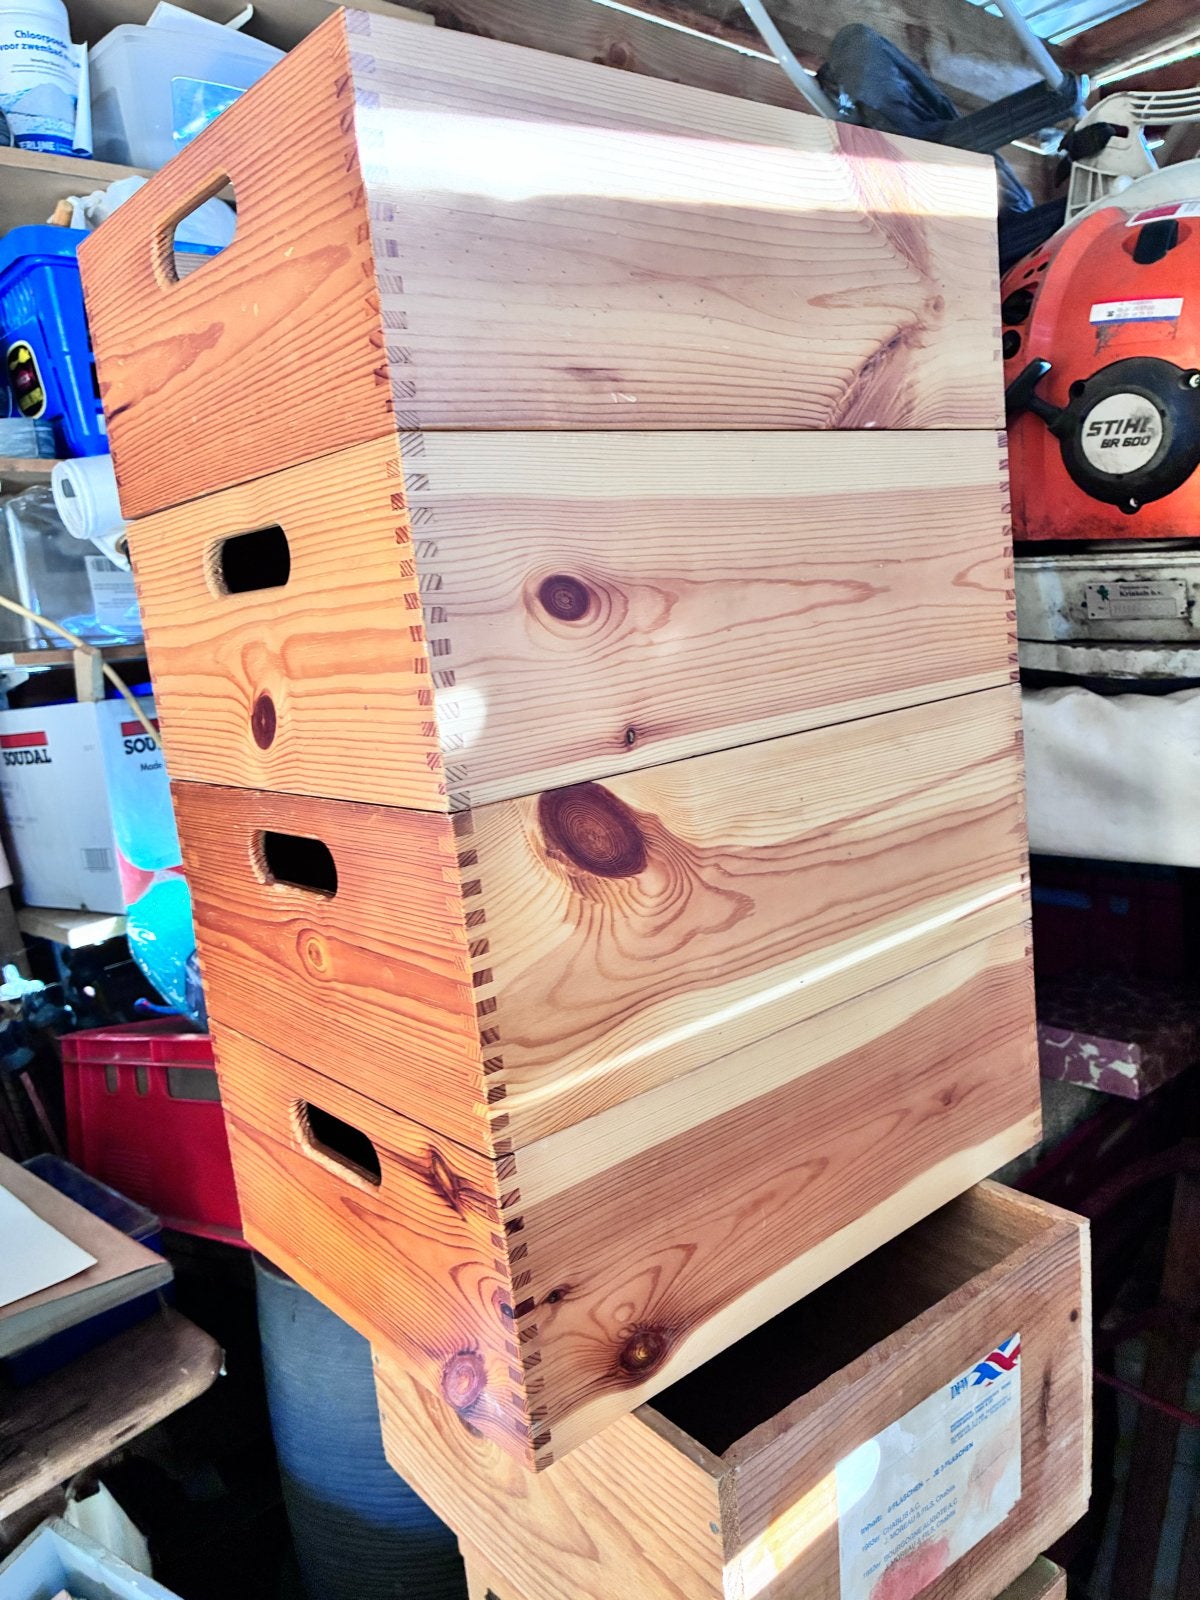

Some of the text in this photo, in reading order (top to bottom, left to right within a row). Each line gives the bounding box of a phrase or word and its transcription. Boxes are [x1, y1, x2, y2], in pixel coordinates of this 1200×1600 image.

[1086, 417, 1148, 437] STIHL
[1100, 436, 1152, 449] BR 600
[3, 748, 52, 766] SOUDAL
